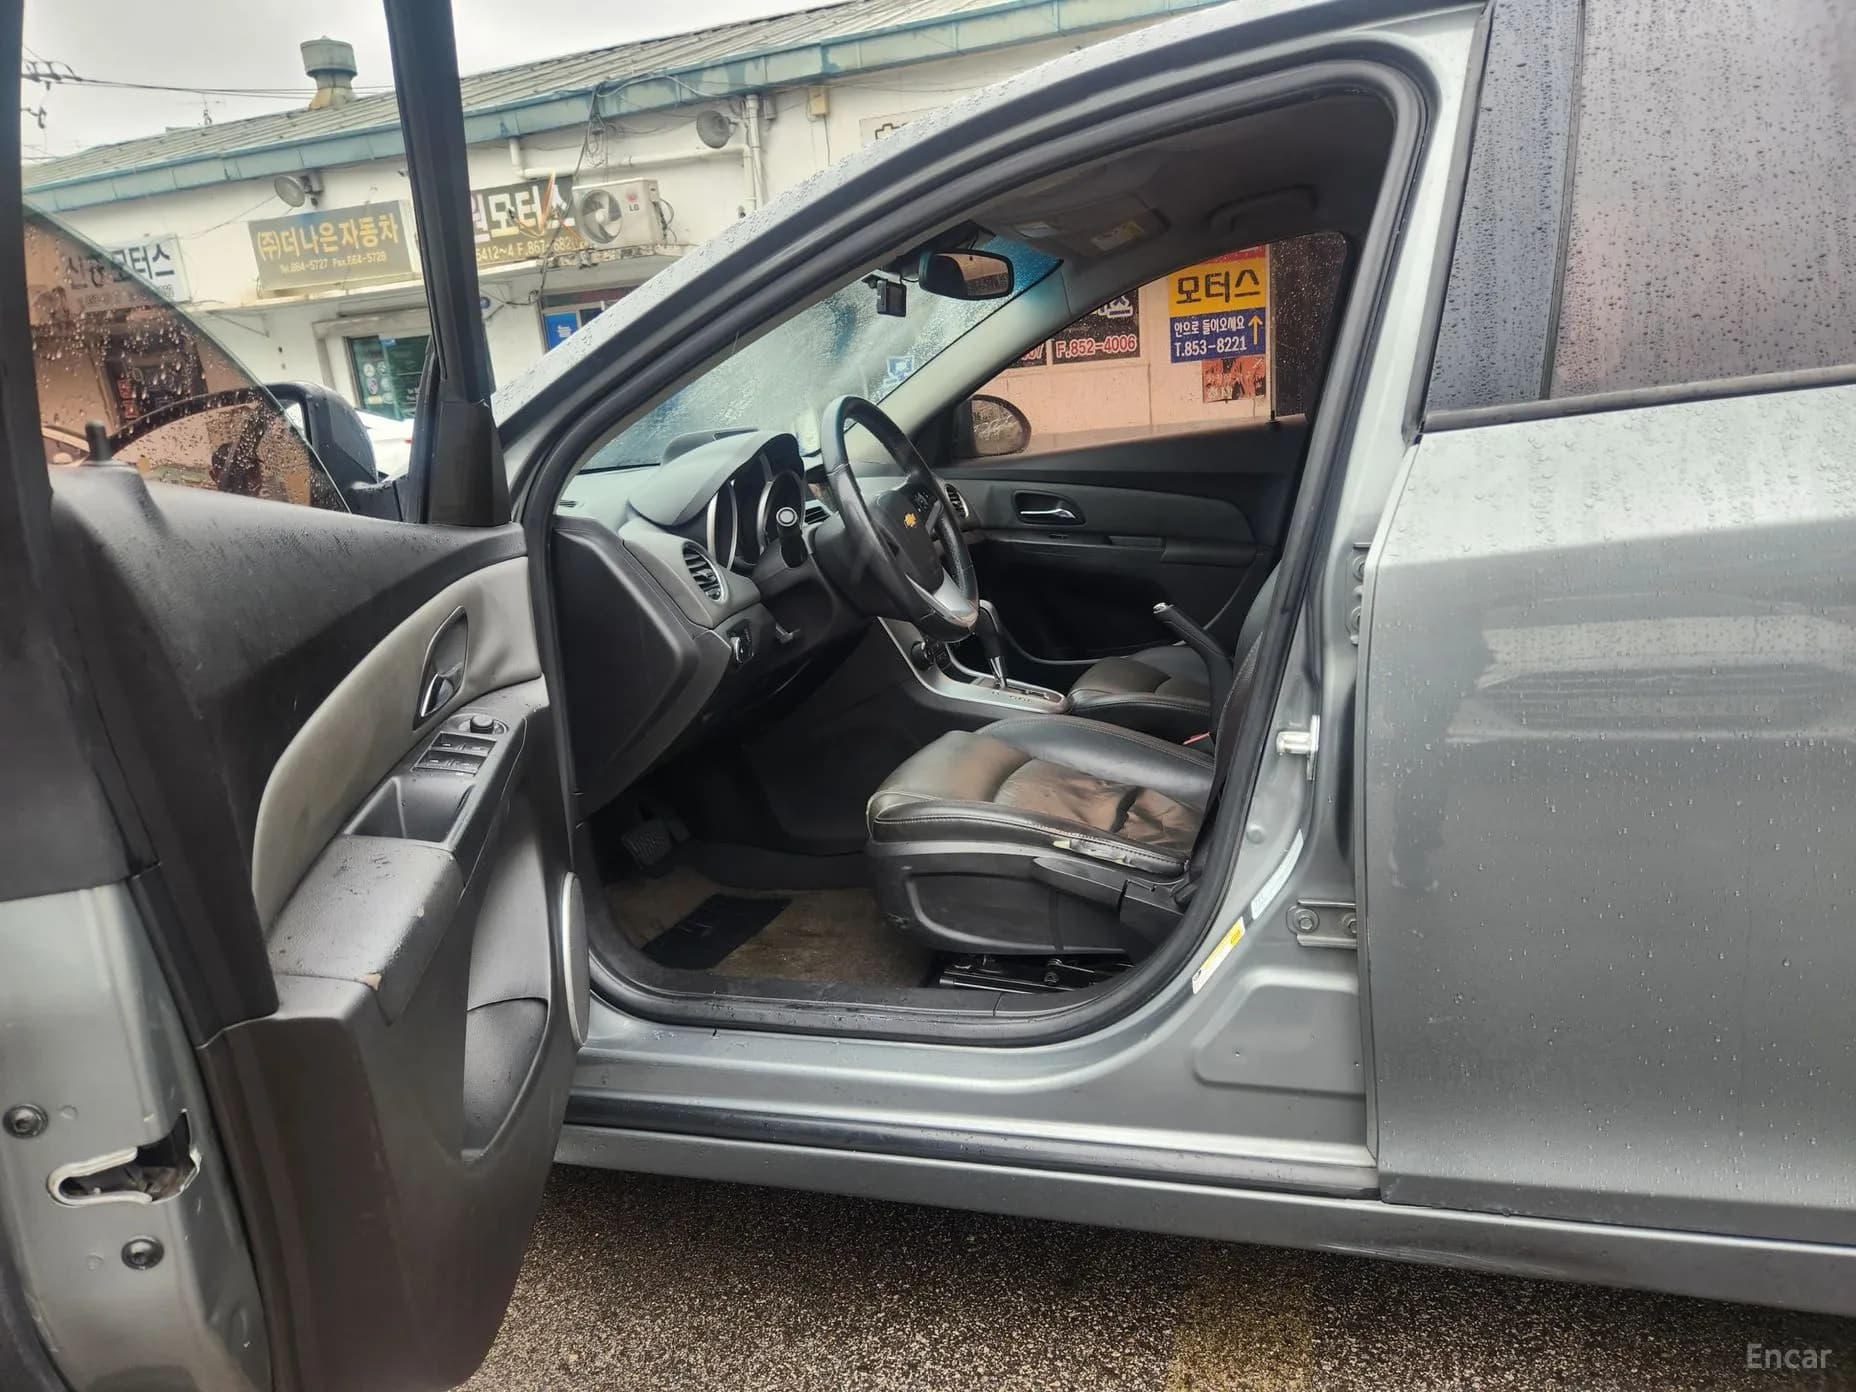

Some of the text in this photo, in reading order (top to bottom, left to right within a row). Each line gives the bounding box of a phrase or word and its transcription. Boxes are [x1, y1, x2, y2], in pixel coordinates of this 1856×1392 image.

[472, 184, 576, 243] 모터스
[629, 203, 640, 212] LG
[257, 212, 399, 261] (주)더나은자동차
[1176, 268, 1260, 304] 모터스
[1174, 320, 1200, 338] 안으로
[1055, 334, 1138, 358] F.852-4006
[1174, 335, 1248, 357] T.853-8221
